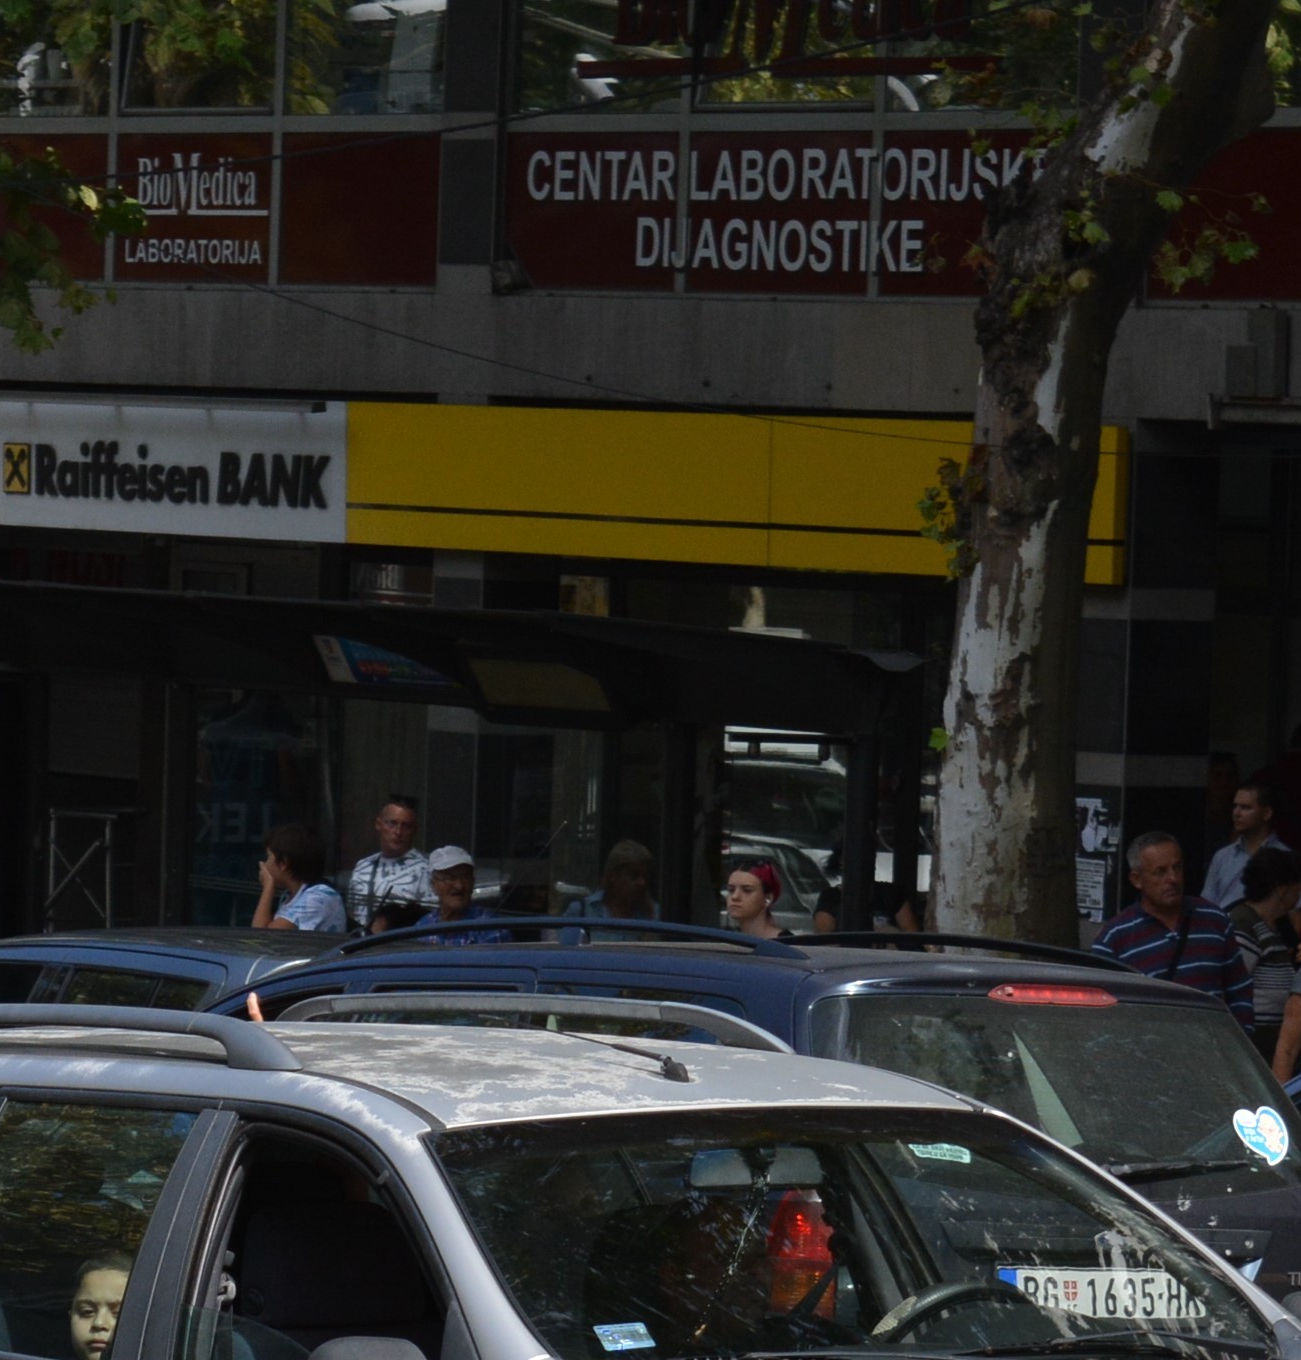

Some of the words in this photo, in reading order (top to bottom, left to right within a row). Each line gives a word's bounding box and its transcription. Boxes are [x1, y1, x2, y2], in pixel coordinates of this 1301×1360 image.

[137, 152, 257, 212] BioMedica
[526, 149, 677, 202] CENTAR
[124, 238, 262, 265] LABORATORIJA
[634, 216, 925, 275] DIJAGNOSTIKE
[35, 441, 209, 505] Raiffeisen
[216, 451, 331, 511] BANK
